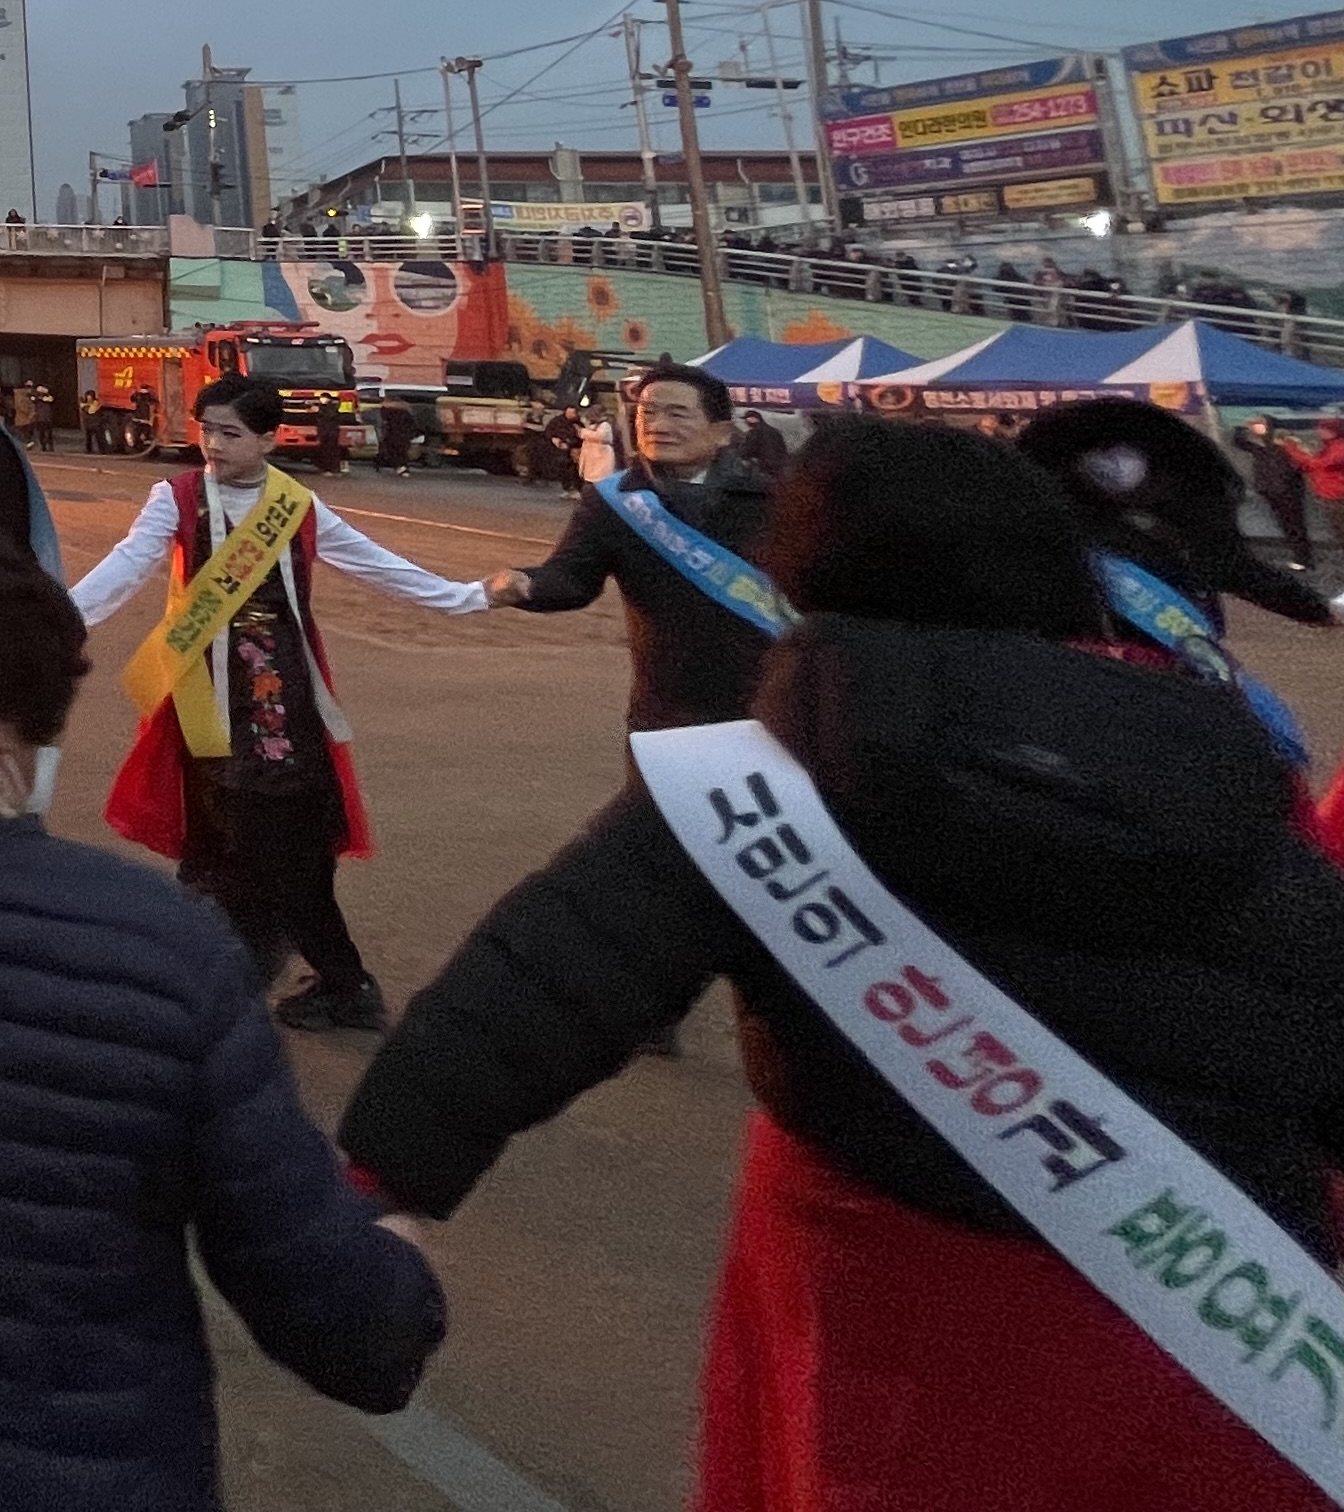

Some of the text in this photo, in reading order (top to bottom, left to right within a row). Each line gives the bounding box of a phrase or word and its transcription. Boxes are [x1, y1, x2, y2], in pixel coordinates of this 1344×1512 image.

[1151, 68, 1218, 99] 소파
[709, 771, 887, 970] 시민의
[863, 964, 1127, 1193] 안녕과
